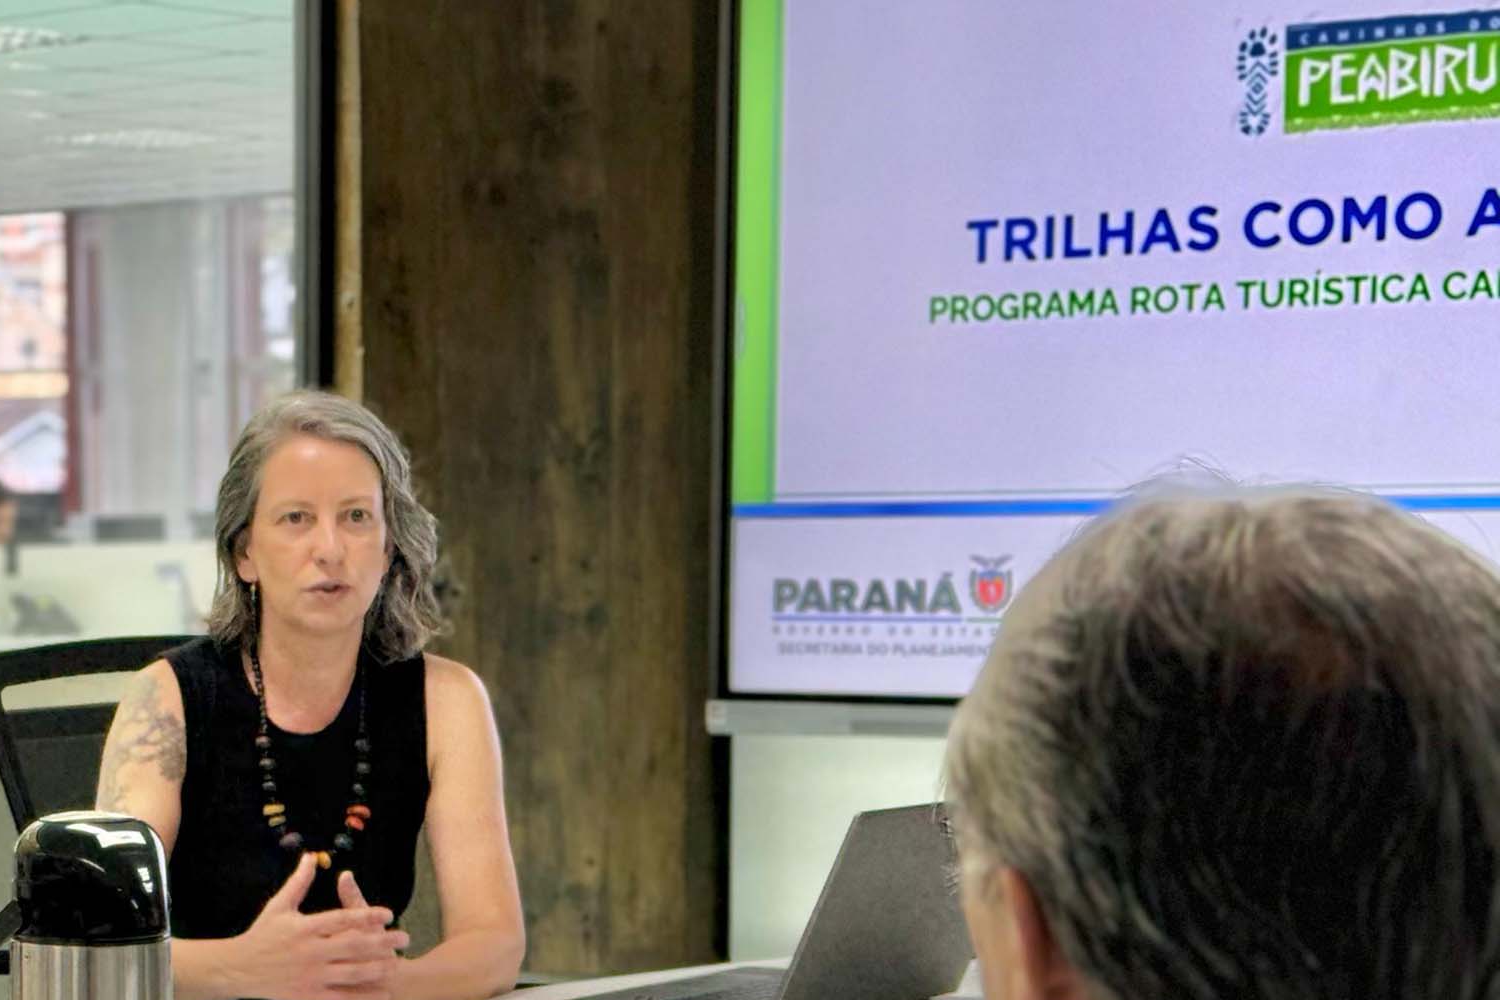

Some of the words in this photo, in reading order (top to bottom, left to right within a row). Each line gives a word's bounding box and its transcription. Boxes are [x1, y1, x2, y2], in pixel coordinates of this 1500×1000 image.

[1299, 20, 1446, 45] CAMINHOS
[1298, 41, 1499, 107] PEABIRU
[966, 206, 1219, 263] TRILHAS
[1243, 192, 1442, 249] COMO
[929, 288, 1119, 323] PROGRAMA
[1130, 283, 1225, 316] ROTA
[1237, 269, 1431, 310] TURÍSTICA
[1442, 269, 1500, 301] CA
[773, 570, 963, 613] PARANÁ
